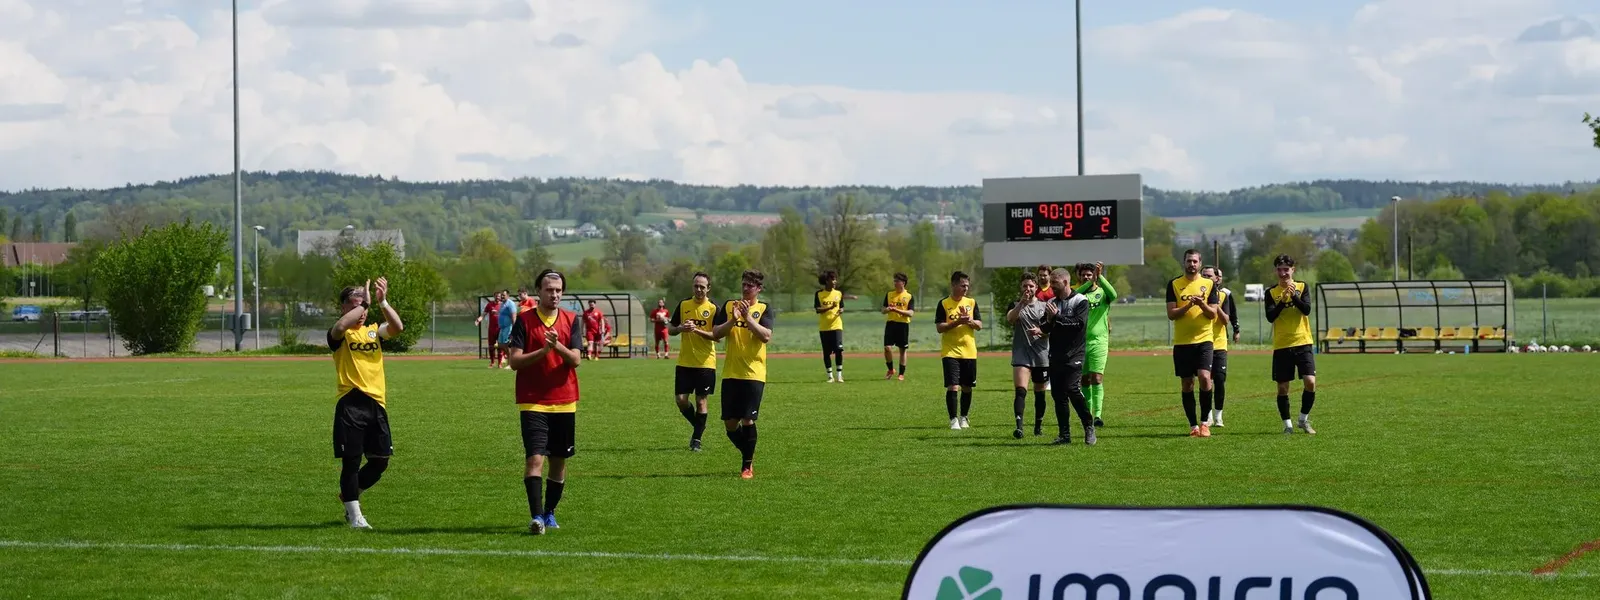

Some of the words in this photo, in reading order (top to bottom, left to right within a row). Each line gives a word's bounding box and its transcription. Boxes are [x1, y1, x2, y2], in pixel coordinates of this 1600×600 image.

[1011, 208, 1033, 218] HEIM
[1039, 203, 1083, 219] 90:00
[1089, 206, 1112, 216] GAST
[1024, 219, 1033, 235] 8
[1064, 222, 1073, 238] 2
[1101, 217, 1110, 233] 2
[349, 342, 379, 352] coop
